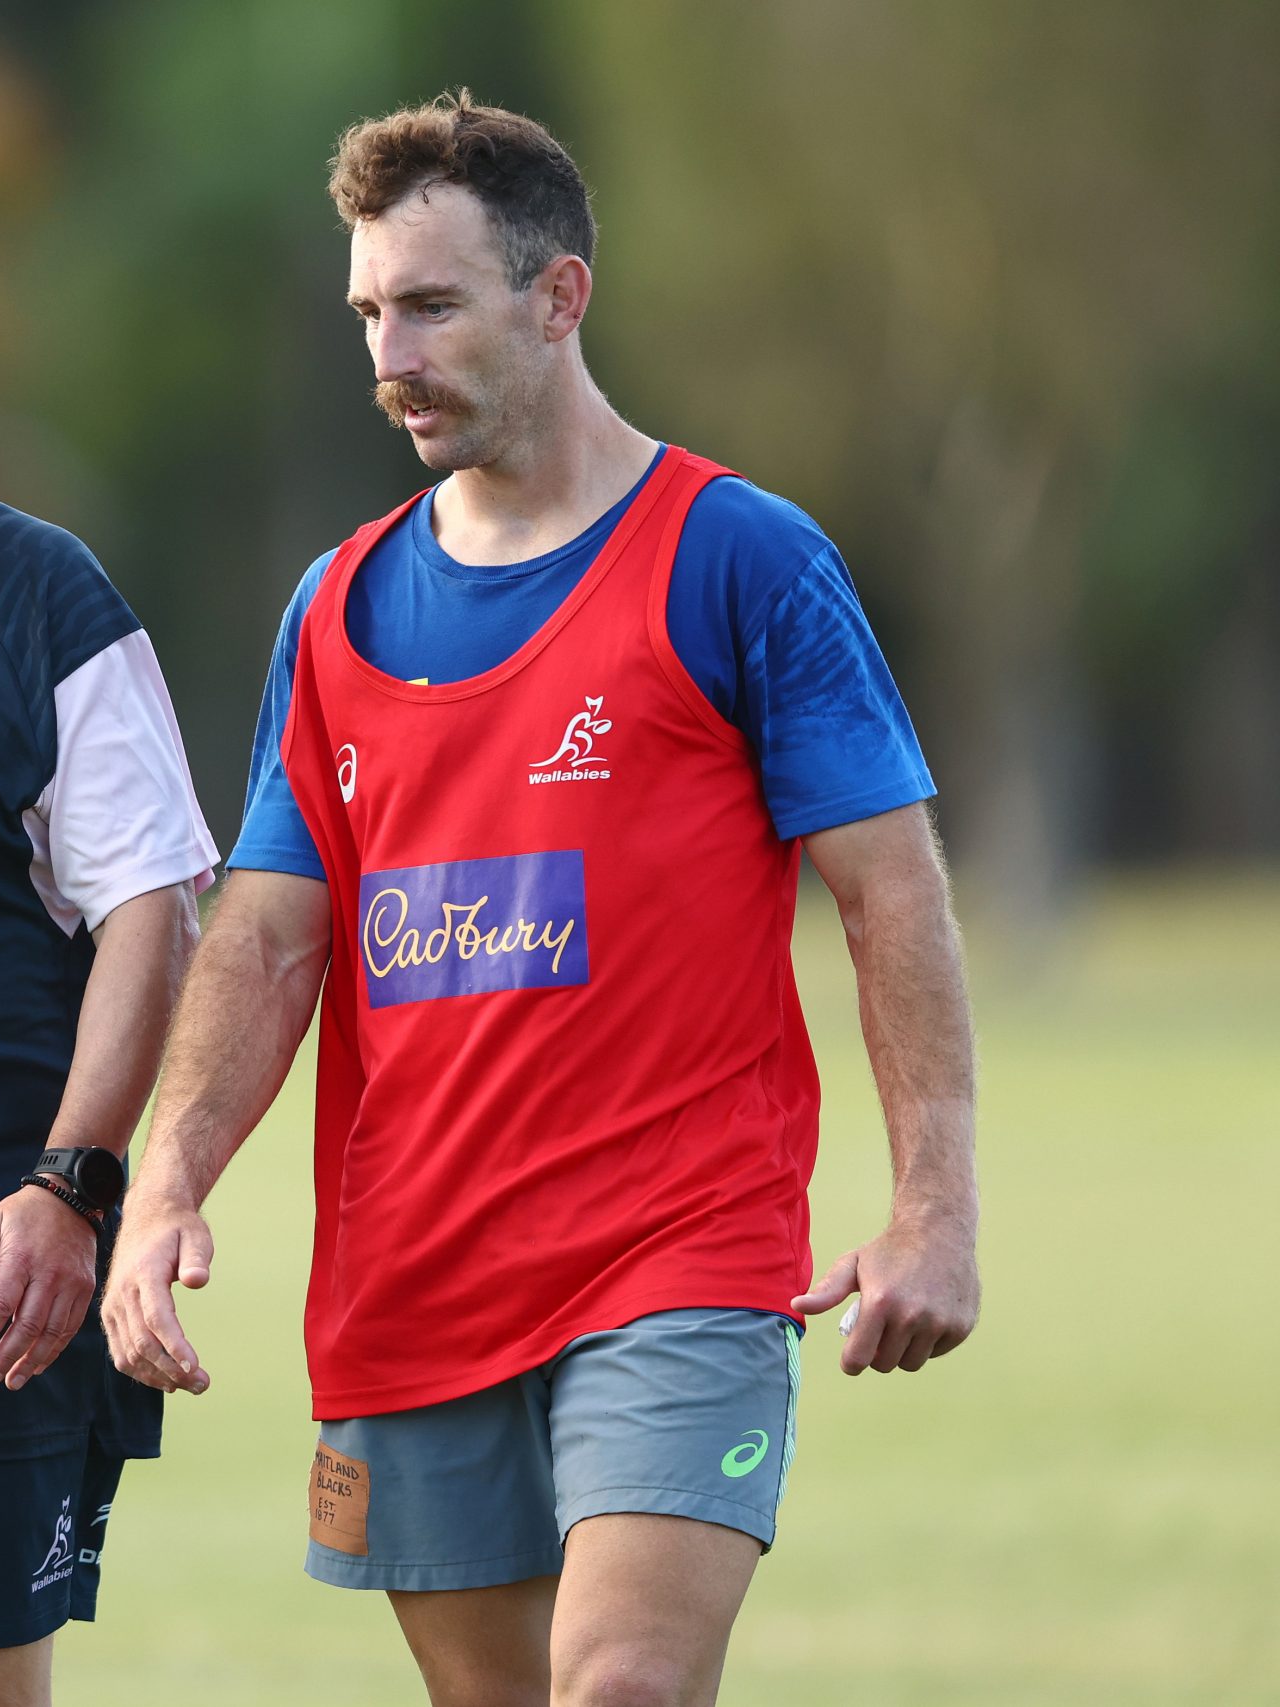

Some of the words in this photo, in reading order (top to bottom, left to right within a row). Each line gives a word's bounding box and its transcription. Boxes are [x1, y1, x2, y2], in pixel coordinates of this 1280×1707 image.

[528, 768, 611, 785] Wallabies
[363, 888, 575, 978] Cadbury
[315, 1509, 335, 1525] 1877
